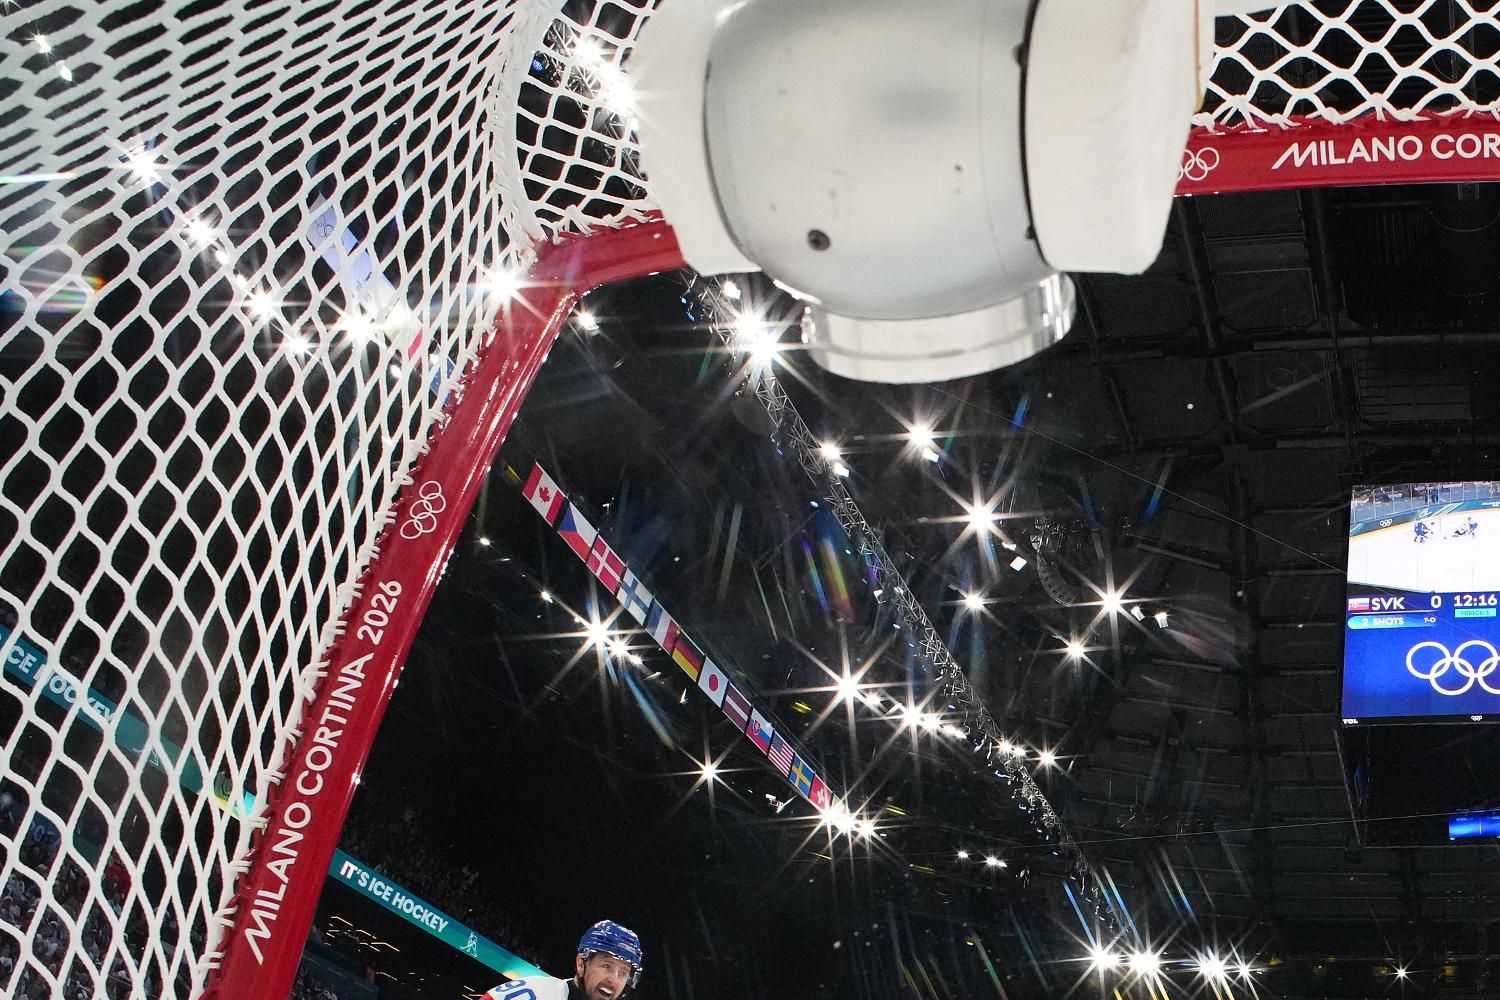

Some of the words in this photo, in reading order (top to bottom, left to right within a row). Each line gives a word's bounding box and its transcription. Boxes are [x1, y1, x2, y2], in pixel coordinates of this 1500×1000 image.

[1271, 135, 1423, 170] MILANO
[1371, 597, 1406, 611] SVK
[1430, 595, 1442, 609] 0
[1453, 593, 1498, 607] 12:16
[1372, 616, 1405, 626] SHOTS
[245, 801, 312, 965] MILANO
[295, 652, 375, 796] CORTINA
[356, 579, 403, 645] 2026
[339, 860, 370, 888] IT'S
[367, 877, 394, 902] ICE
[391, 891, 449, 933] HOCKEY
